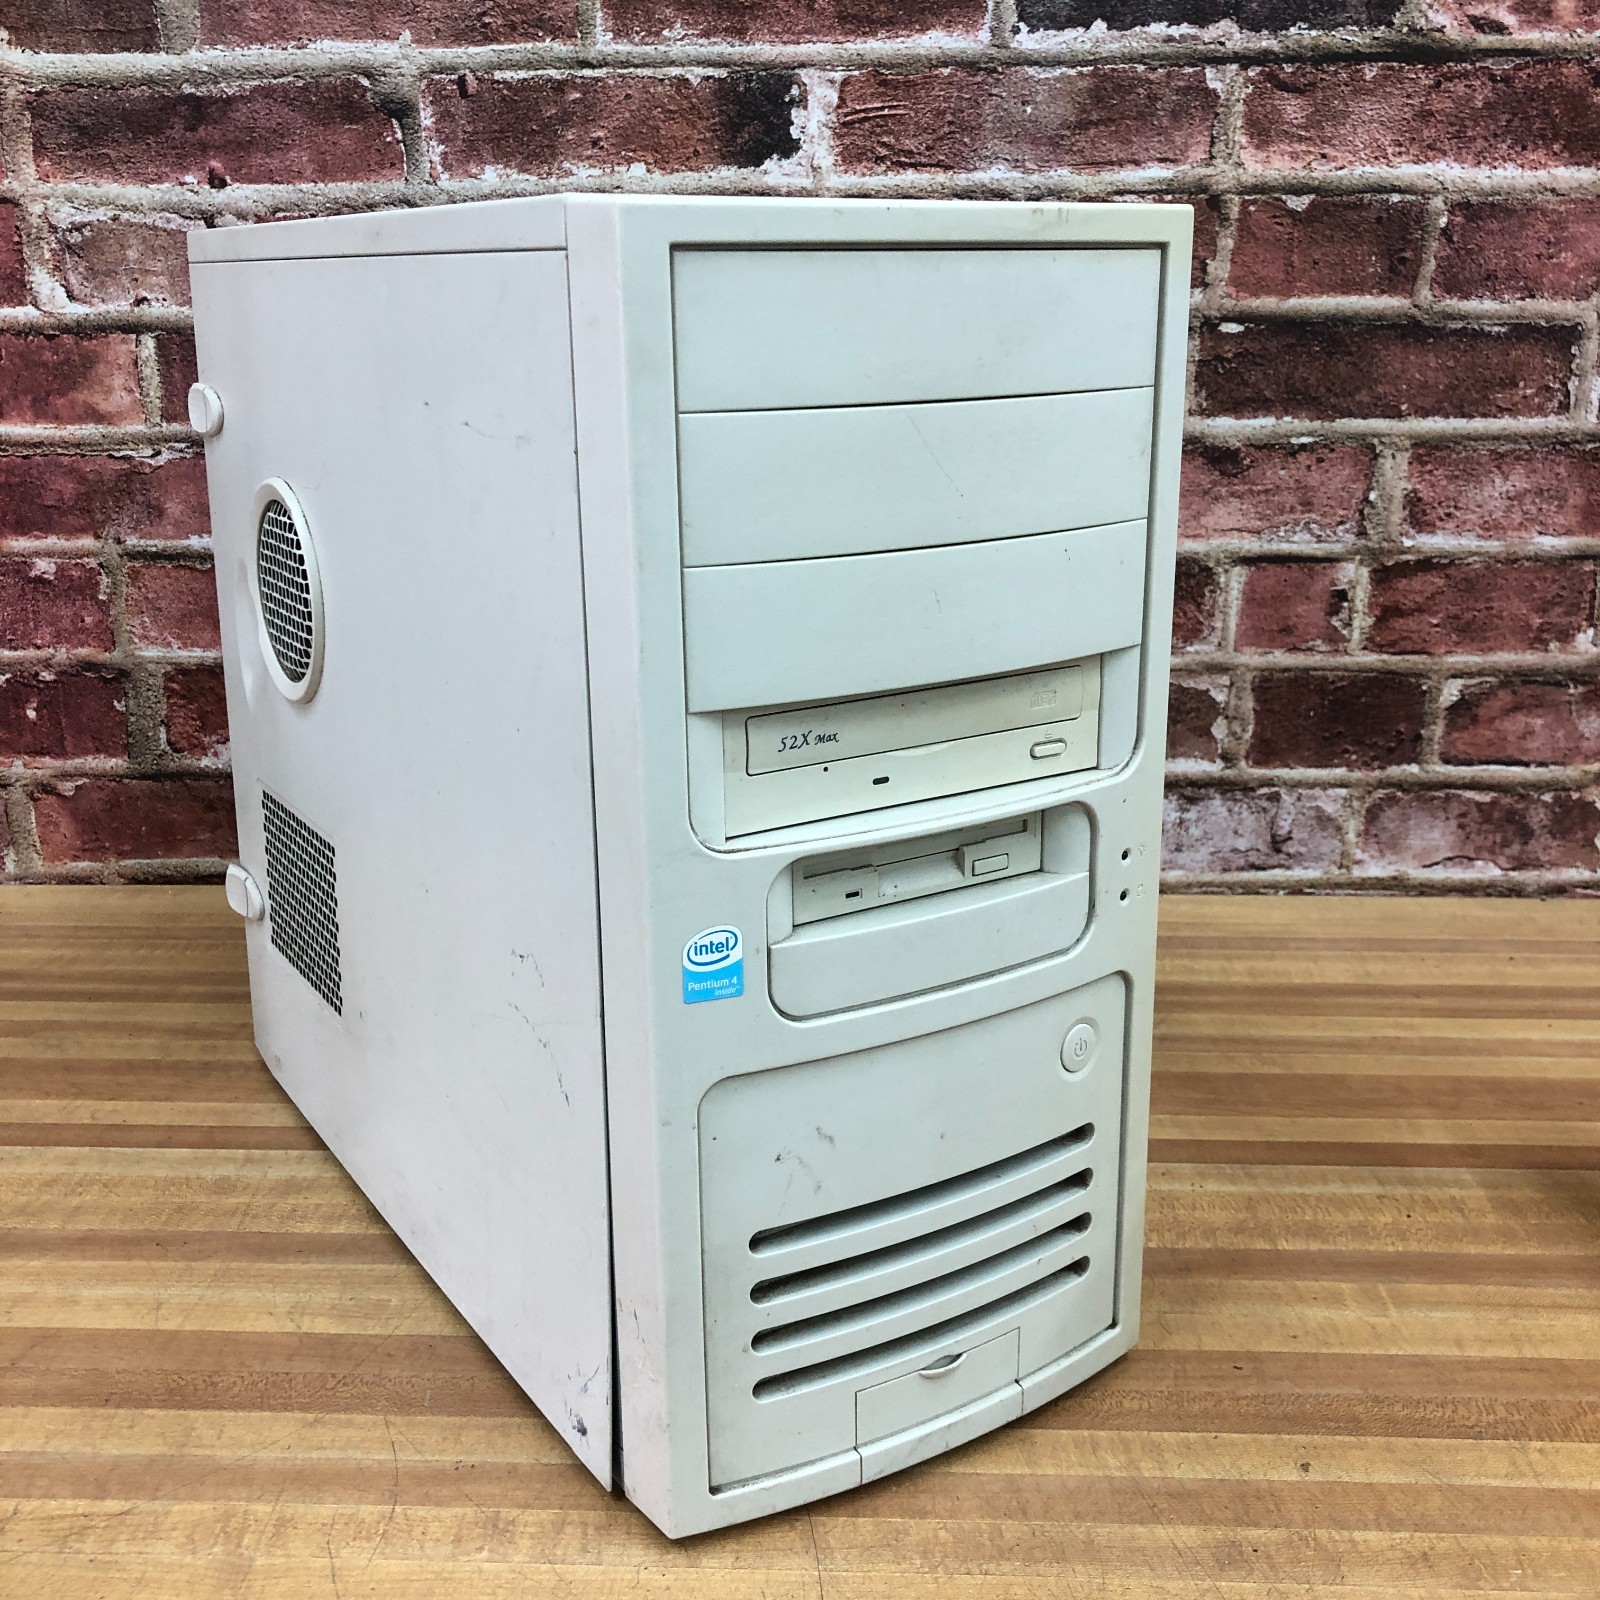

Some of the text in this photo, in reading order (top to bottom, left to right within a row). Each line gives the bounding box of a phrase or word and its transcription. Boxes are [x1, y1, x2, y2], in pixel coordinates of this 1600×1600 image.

[778, 730, 840, 752] 52X Max
[694, 937, 730, 956] intel
[688, 976, 738, 991] Pentium 4
